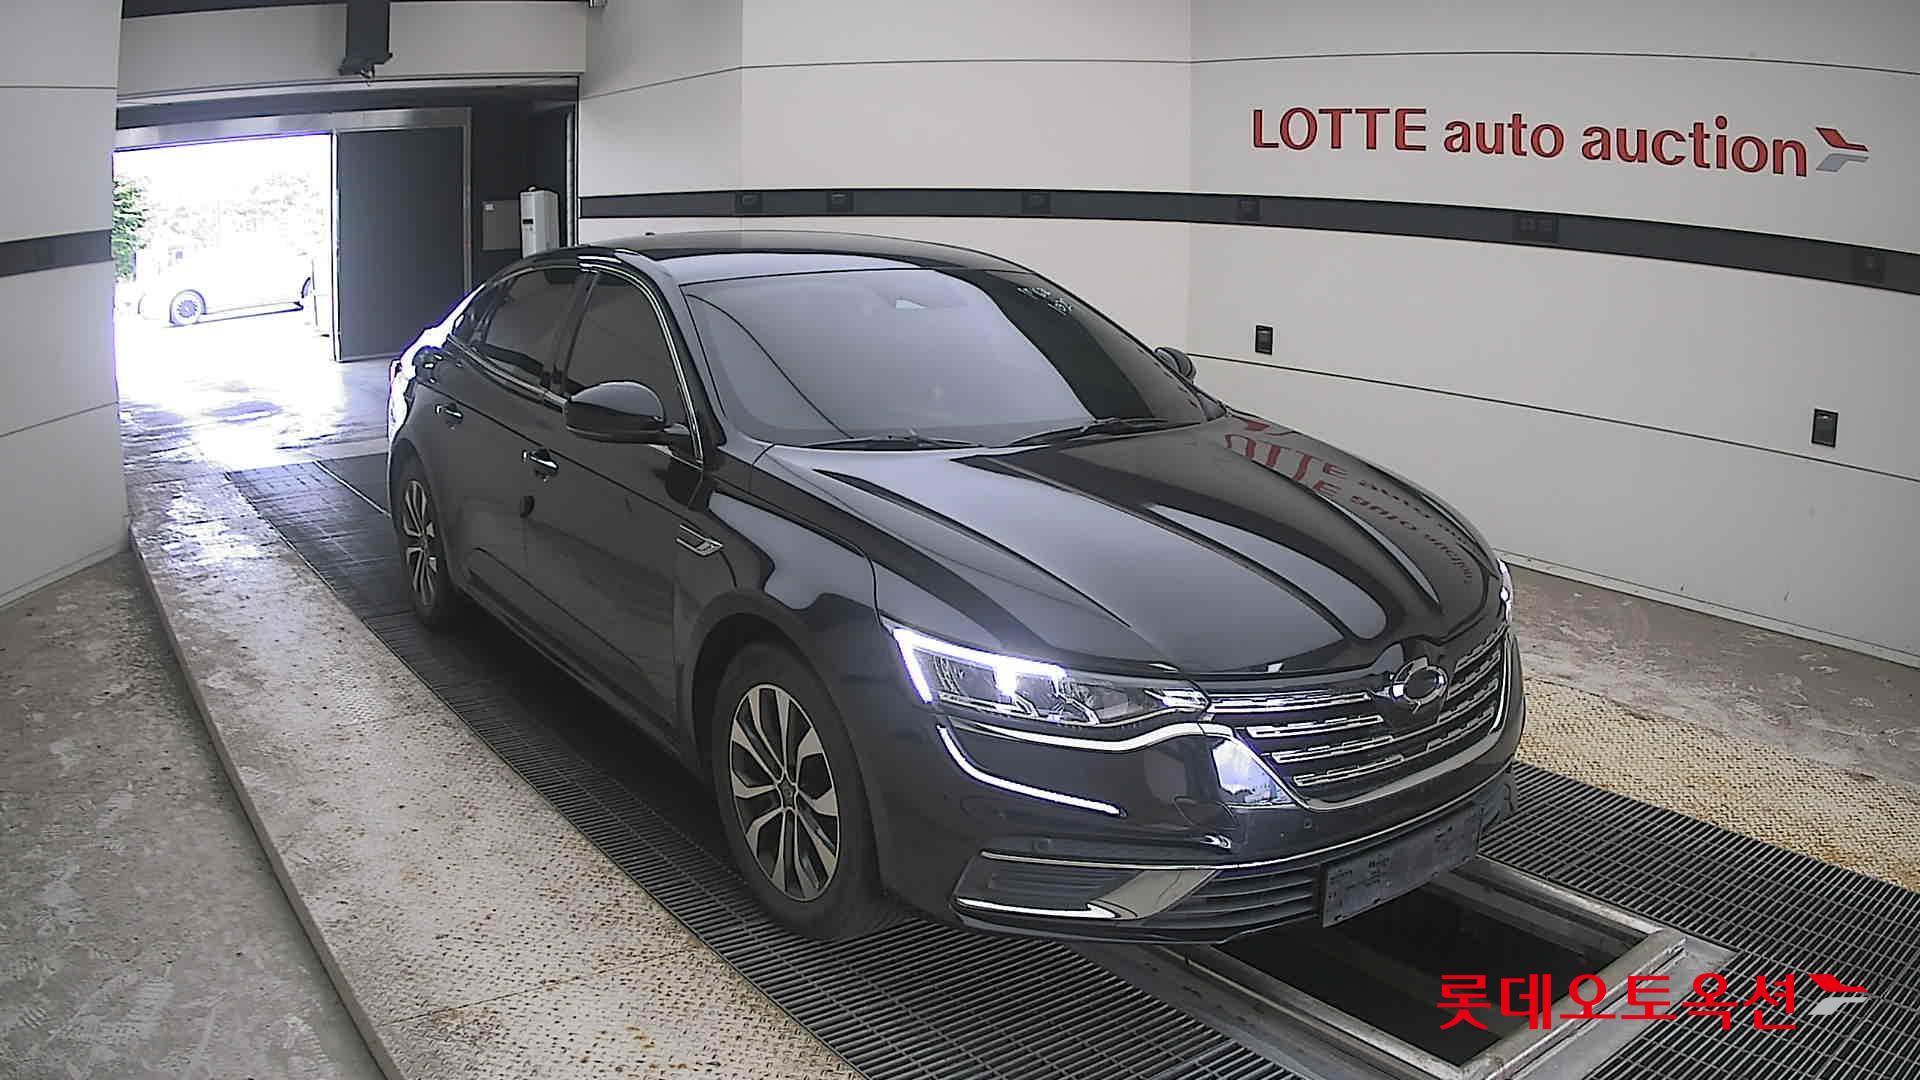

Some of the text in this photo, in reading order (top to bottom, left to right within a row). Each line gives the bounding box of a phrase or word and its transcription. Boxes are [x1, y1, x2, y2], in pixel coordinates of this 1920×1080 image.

[1252, 107, 1808, 177] LOTTE auto auction
